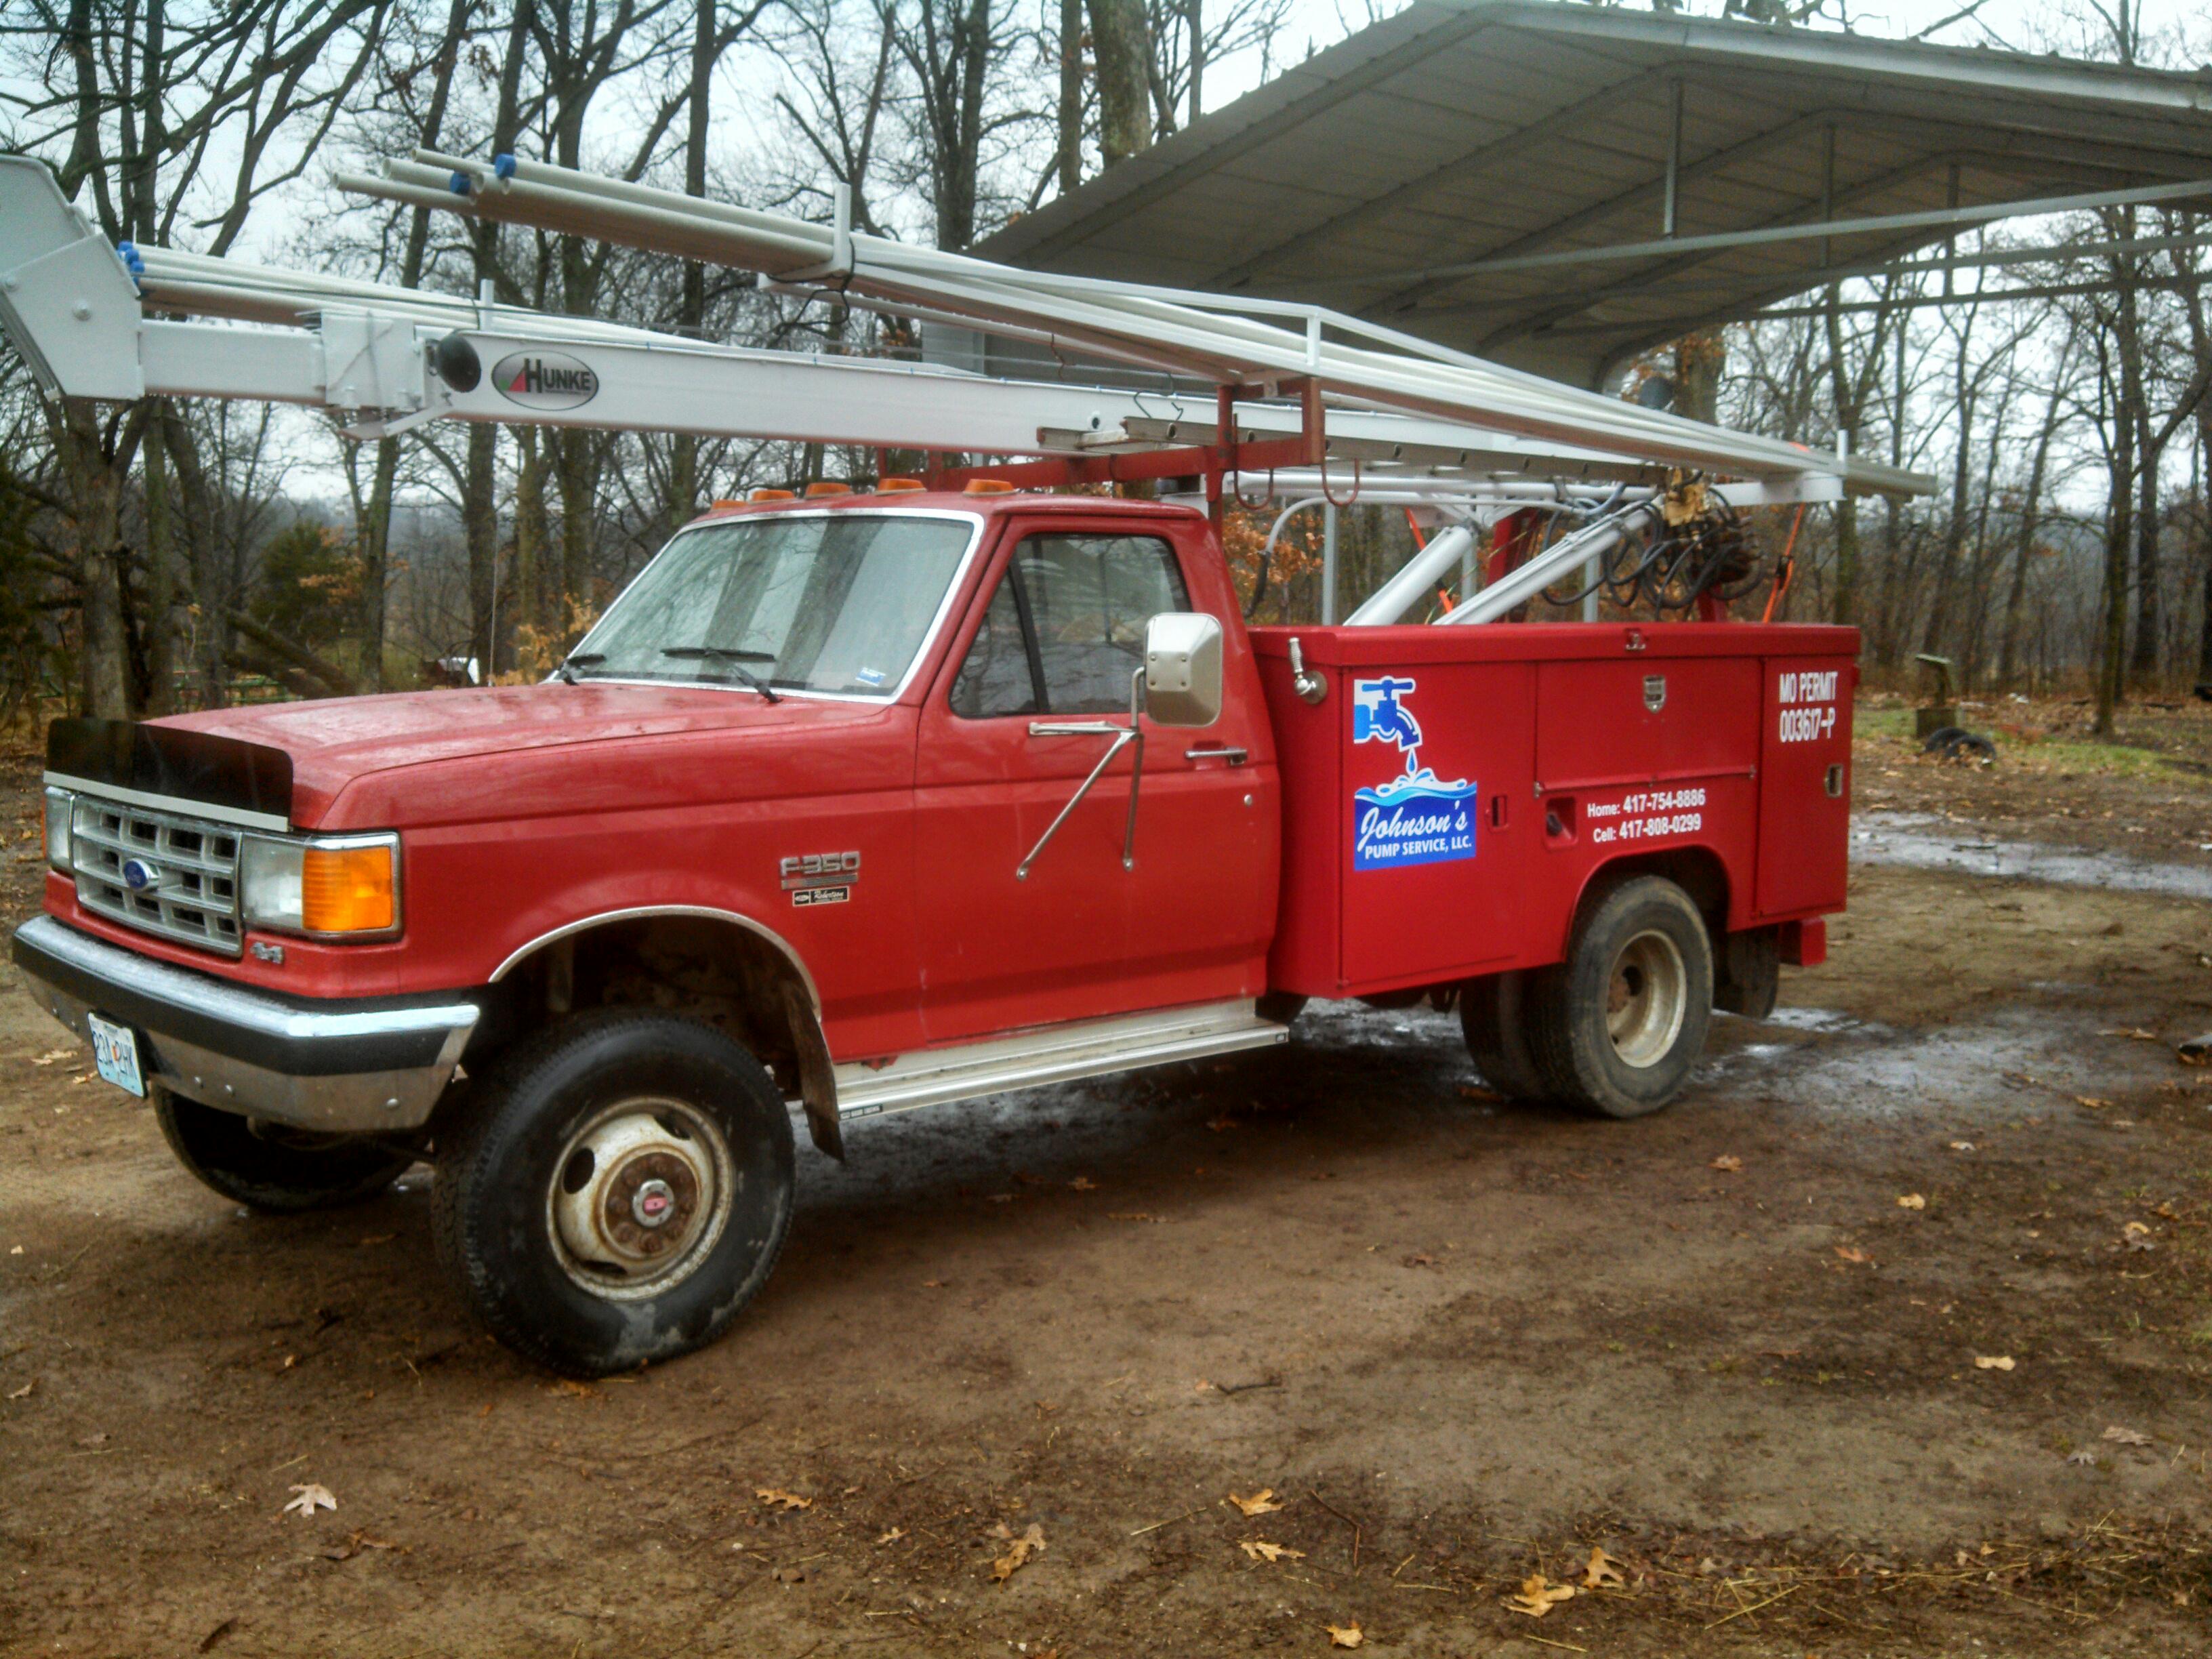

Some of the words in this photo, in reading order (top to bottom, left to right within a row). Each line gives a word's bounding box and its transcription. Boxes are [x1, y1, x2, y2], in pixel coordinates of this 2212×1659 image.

[525, 358, 591, 393] HUNKE
[1799, 671, 1838, 702] PERMIT
[1587, 803, 1620, 817] Home:
[1623, 788, 1706, 813] 417-754-8886
[1357, 800, 1468, 853] Johnson's
[1593, 827, 1617, 842] Cell:
[1619, 813, 1702, 839] 417-808-0299
[1365, 845, 1400, 860] PUMP
[1402, 838, 1449, 855] SERVICE,
